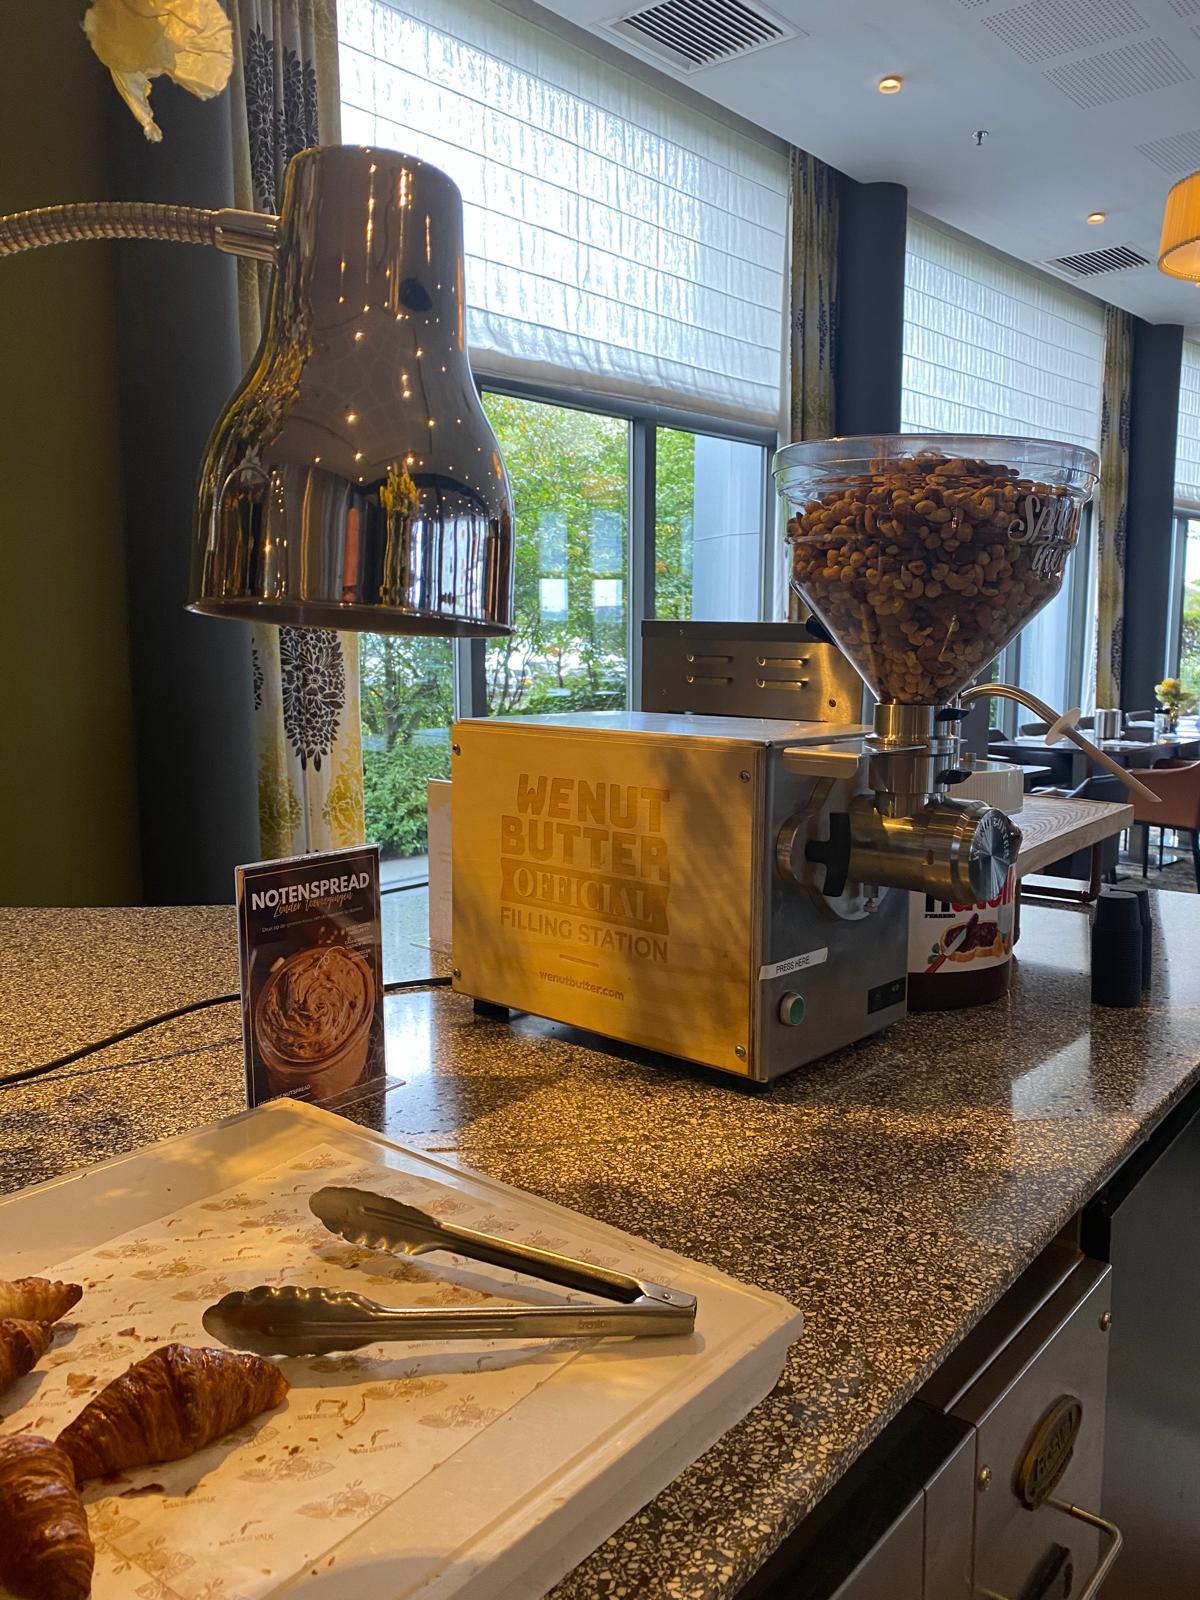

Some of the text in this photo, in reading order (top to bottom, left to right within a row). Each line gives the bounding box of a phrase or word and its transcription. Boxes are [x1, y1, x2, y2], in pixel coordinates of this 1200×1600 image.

[516, 773, 671, 833] WENUT
[501, 814, 671, 882] BUTTER
[251, 872, 370, 911] NOTENSPREAD
[512, 867, 655, 922] OFFICIAL
[500, 905, 670, 964] FILLING STATION
[538, 969, 625, 1001] wenutbutter.com
[776, 954, 810, 974] PRESS HERE
